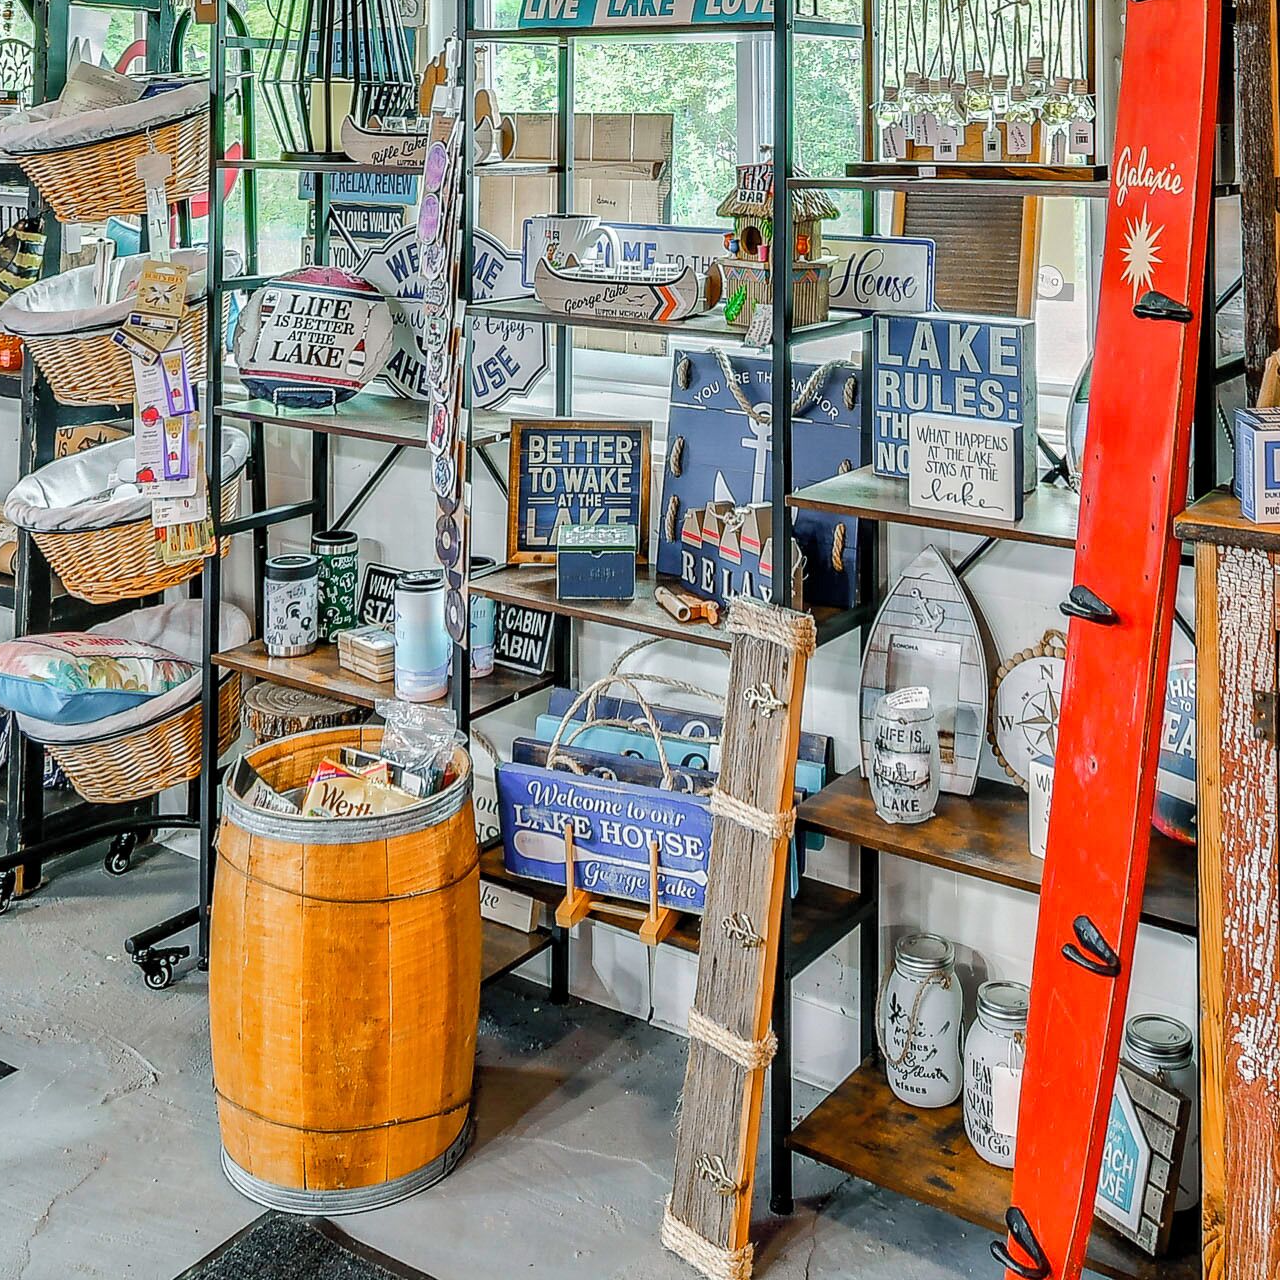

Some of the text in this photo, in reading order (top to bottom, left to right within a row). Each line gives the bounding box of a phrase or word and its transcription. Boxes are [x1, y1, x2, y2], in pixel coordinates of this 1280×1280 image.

[371, 136, 428, 165] Rifle Lake
[1116, 145, 1184, 207] Galaxie
[739, 191, 764, 203] BAR
[342, 211, 401, 232] LONG WALKS
[826, 248, 918, 304] House
[287, 295, 352, 320] LIFE
[564, 283, 629, 313] George Lake
[274, 315, 355, 335] IS BETTER
[287, 330, 336, 345] AT THE
[486, 317, 533, 341] Enjoy
[270, 341, 345, 369] LAKE
[878, 318, 1018, 377] LAKE
[693, 381, 720, 404] YOU
[878, 369, 1019, 420] RULES:
[528, 435, 633, 464] BETTER
[917, 425, 1008, 451] WHAT HAPPENS
[928, 448, 965, 462] AT THE
[528, 467, 631, 493] TO WAKE
[925, 460, 1000, 482] STAYS AT THE
[557, 493, 602, 507] AT THE
[920, 478, 1004, 511] lake
[506, 606, 546, 637] CABIN
[892, 642, 919, 651] SONOMA
[1039, 663, 1054, 680] N
[879, 725, 922, 742] LIFE IS
[527, 780, 686, 827] Welcome to our
[882, 795, 920, 811] LAKE
[513, 804, 705, 861] LAKE HOUSE
[894, 1079, 927, 1094] kisses
